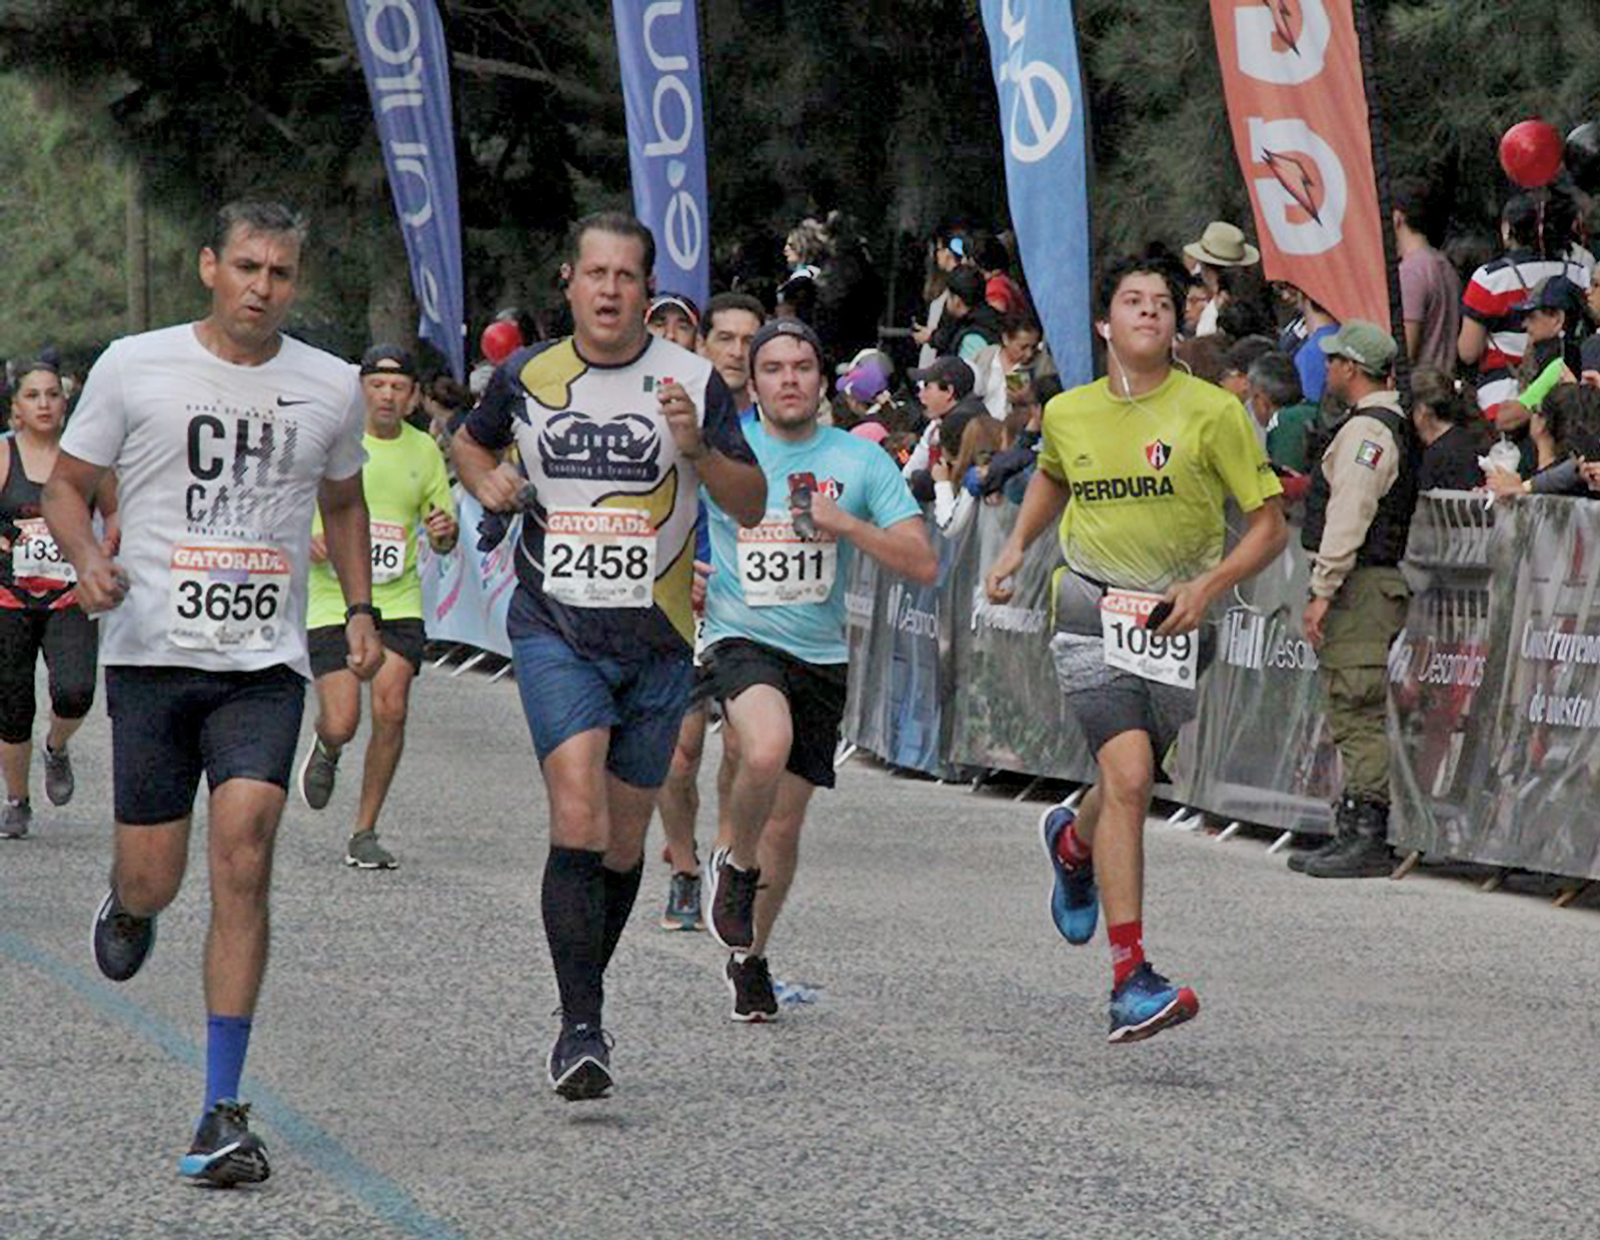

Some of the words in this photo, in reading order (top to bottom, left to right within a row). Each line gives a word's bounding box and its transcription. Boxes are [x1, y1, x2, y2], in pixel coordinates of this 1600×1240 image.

[1072, 475, 1175, 501] PERDURA
[547, 514, 651, 533] GATORADE
[551, 543, 648, 580] 2458
[746, 550, 823, 582] 3311
[177, 580, 279, 621] 3656
[1110, 621, 1191, 662] 1099
